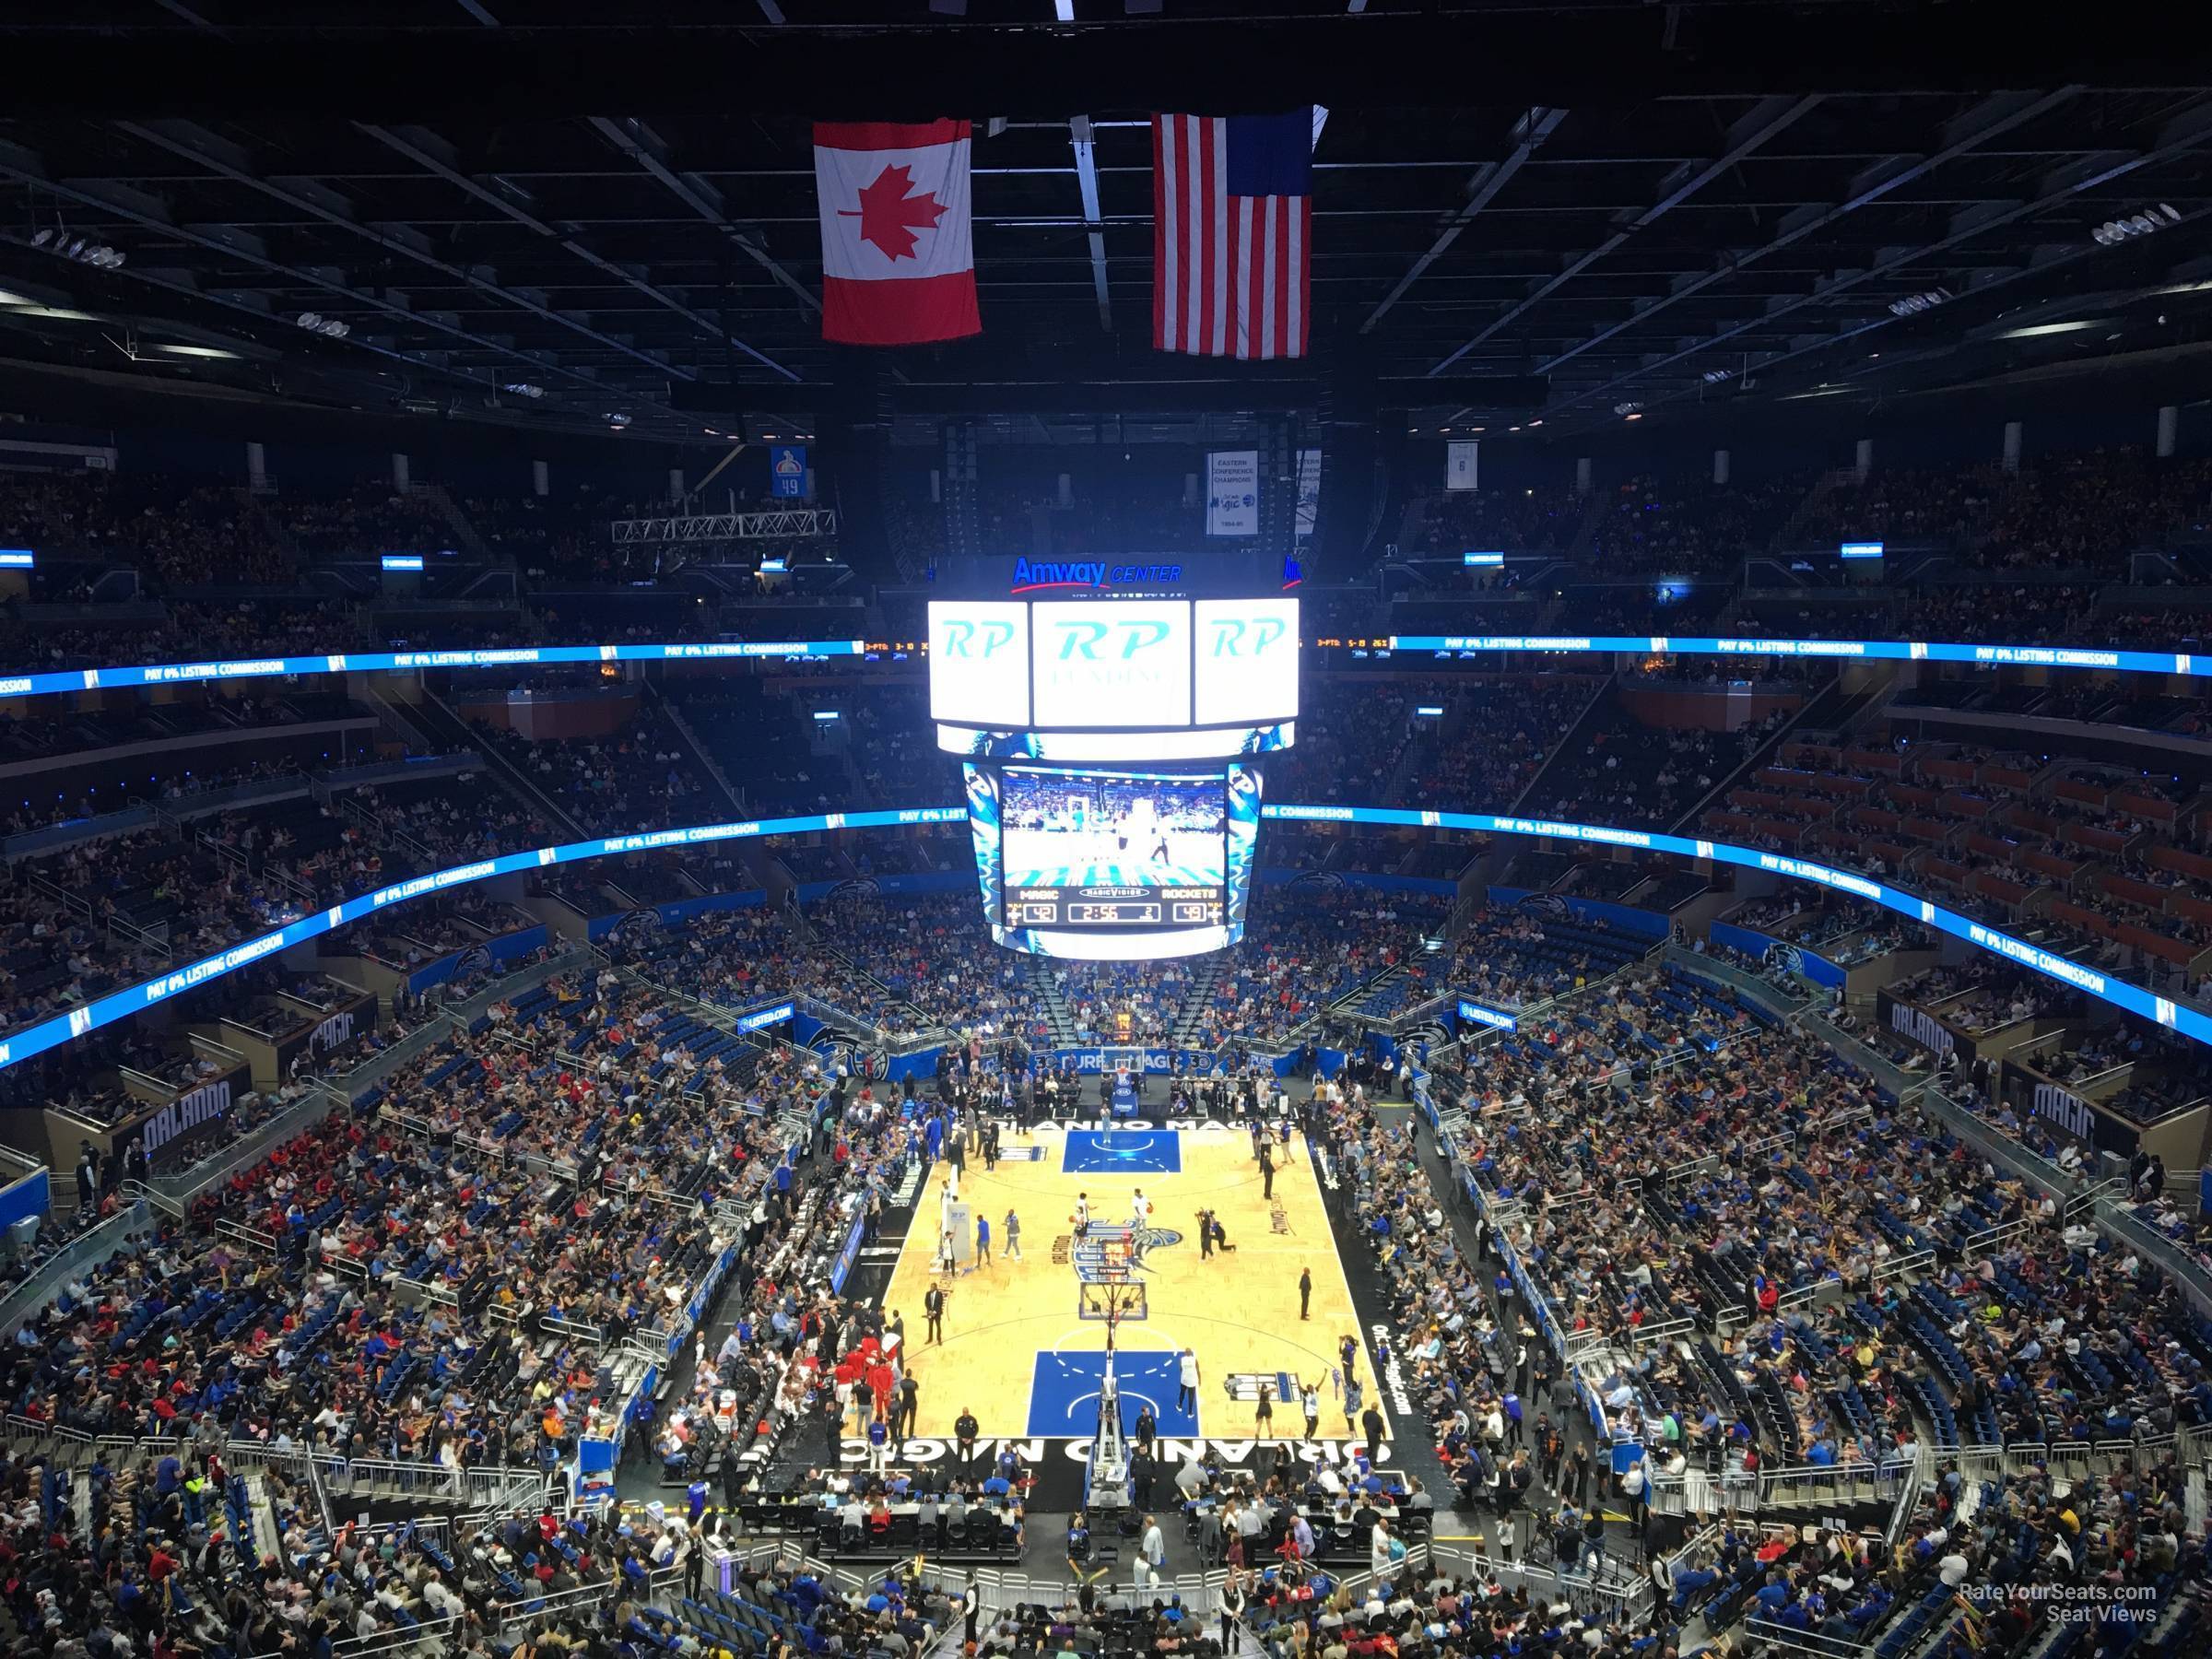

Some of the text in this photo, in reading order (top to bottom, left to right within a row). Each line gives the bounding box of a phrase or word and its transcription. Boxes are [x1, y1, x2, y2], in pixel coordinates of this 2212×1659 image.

[1013, 557, 1182, 587] Amway CENTER
[942, 619, 1014, 658] RP
[1054, 620, 1171, 660] RP
[1210, 617, 1286, 657] RP
[1445, 638, 1464, 648] PAY
[1484, 638, 1522, 649] LISTING
[1524, 638, 1590, 649] COMMISSION
[665, 646, 683, 656] PAY
[704, 644, 741, 654] LISTING
[744, 643, 807, 654] COMMISSION
[1718, 641, 1736, 651] PAY
[1756, 641, 1795, 653] LISTING
[1797, 642, 1865, 654] COMMISSION
[1976, 647, 1994, 659] PAY
[2014, 650, 2054, 663] LISTING
[2056, 652, 2118, 666] COMMISSION
[394, 655, 414, 665] PAY
[432, 653, 473, 664] LISTING
[474, 650, 539, 663] COMMISSION
[145, 669, 162, 680] PAY
[181, 665, 217, 678] LISTING
[218, 661, 284, 676] COMMISSION
[900, 810, 920, 822] PAY
[943, 808, 967, 820] LIST
[1279, 806, 1353, 819] COMMISSION
[605, 839, 625, 852] PAY
[645, 831, 687, 846] LISTING
[688, 823, 759, 841] COMMISSION
[1494, 818, 1514, 830] PAY
[1535, 822, 1579, 837] LISTING
[1581, 828, 1650, 845] COMMISSION
[373, 890, 388, 906] PAY
[403, 877, 435, 898] LISTING
[436, 862, 495, 887] COMMISSION
[1760, 855, 1779, 868] PAY
[1796, 863, 1830, 882] LISTING
[1831, 872, 1881, 900] COMMISSION
[1020, 890, 1059, 900] MAGIC
[1161, 889, 1218, 900] ROCKETS
[1033, 906, 1052, 921] 42
[1083, 906, 1119, 921] 2:56
[1182, 906, 1200, 921] 49
[147, 979, 167, 1001] PAY
[186, 957, 226, 983] LISTING
[226, 933, 283, 968] COMMISSION
[1970, 924, 1986, 942] PAY
[2002, 938, 2037, 965] LISTING
[2039, 954, 2105, 993] COMMISSION
[1891, 1002, 1954, 1056] ORLANDO
[1128, 1053, 1183, 1069] MAGI
[143, 1080, 230, 1152] ORLANDO
[2034, 1083, 2095, 1142] MAGIC
